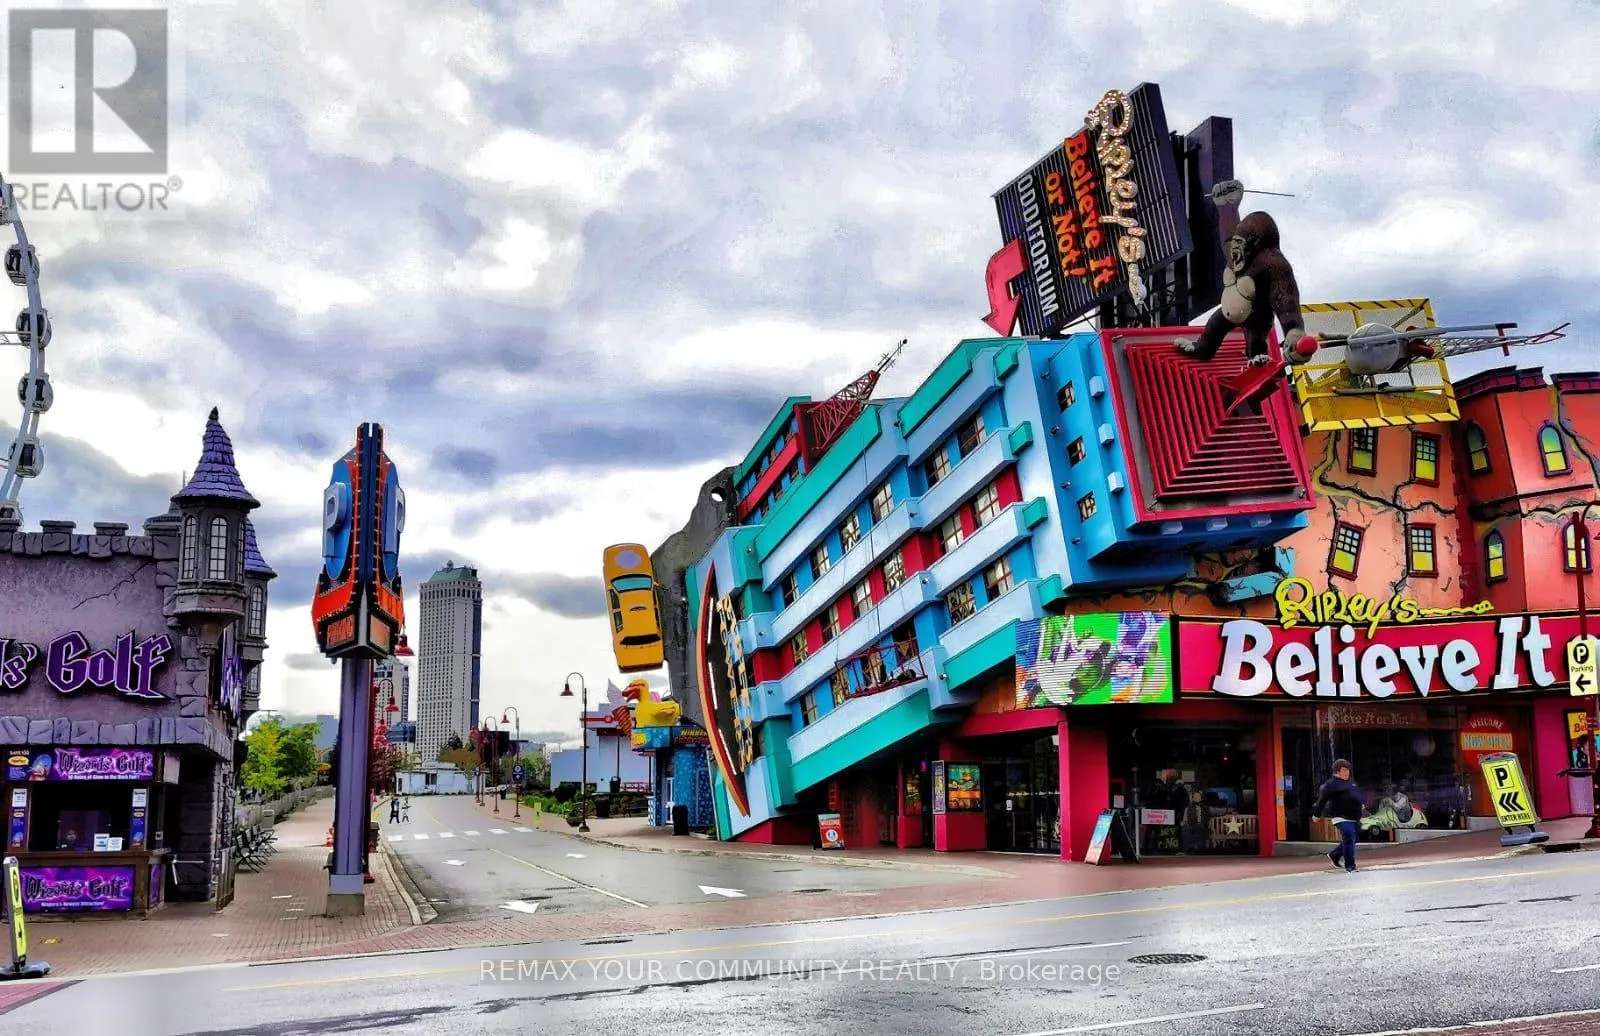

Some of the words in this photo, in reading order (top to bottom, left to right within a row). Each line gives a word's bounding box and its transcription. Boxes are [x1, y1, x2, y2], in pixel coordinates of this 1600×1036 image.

[1064, 131, 1105, 250] Believe
[1089, 256, 1117, 289] It
[1017, 174, 1060, 316] ODDITORIUM
[1052, 209, 1088, 278] Not!
[0, 638, 39, 689] s'
[46, 630, 173, 699] Golf
[1212, 619, 1481, 698] Believe
[1493, 615, 1556, 691] It
[1570, 664, 1594, 674] Parking
[1575, 645, 1588, 663] P
[1470, 717, 1504, 730] WELCOME
[1495, 767, 1508, 787] P
[1500, 813, 1517, 822] ENTER
[1517, 812, 1530, 820] HERE
